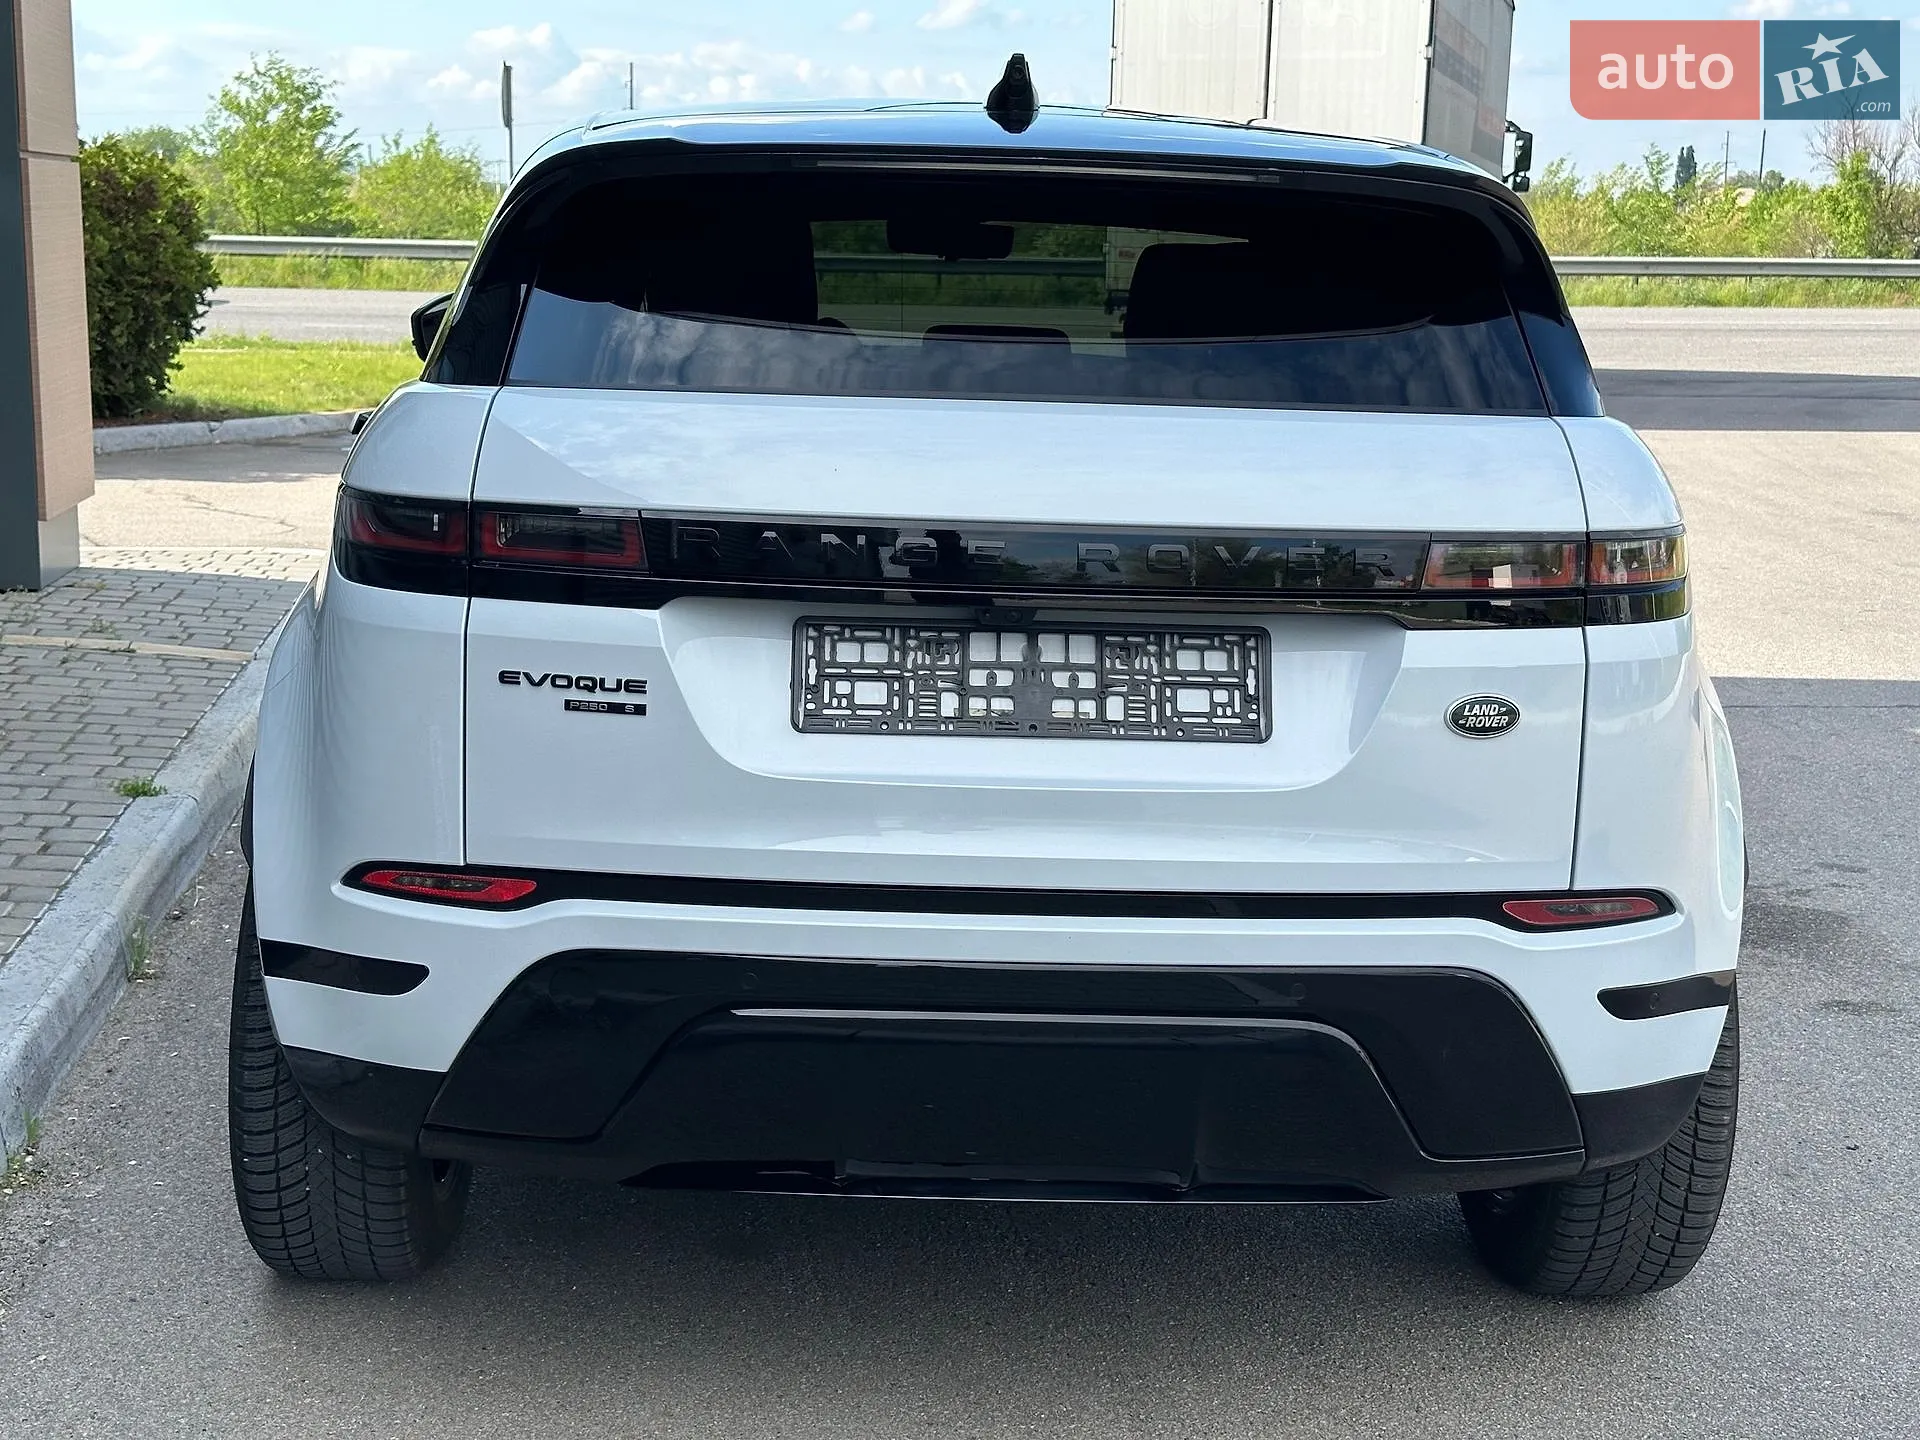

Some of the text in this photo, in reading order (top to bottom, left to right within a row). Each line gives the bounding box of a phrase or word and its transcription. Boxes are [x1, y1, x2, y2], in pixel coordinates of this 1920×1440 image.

[672, 523, 1397, 577] RANGE ROVER
[498, 669, 648, 694] EVOQUE
[569, 701, 635, 713] P250 S
